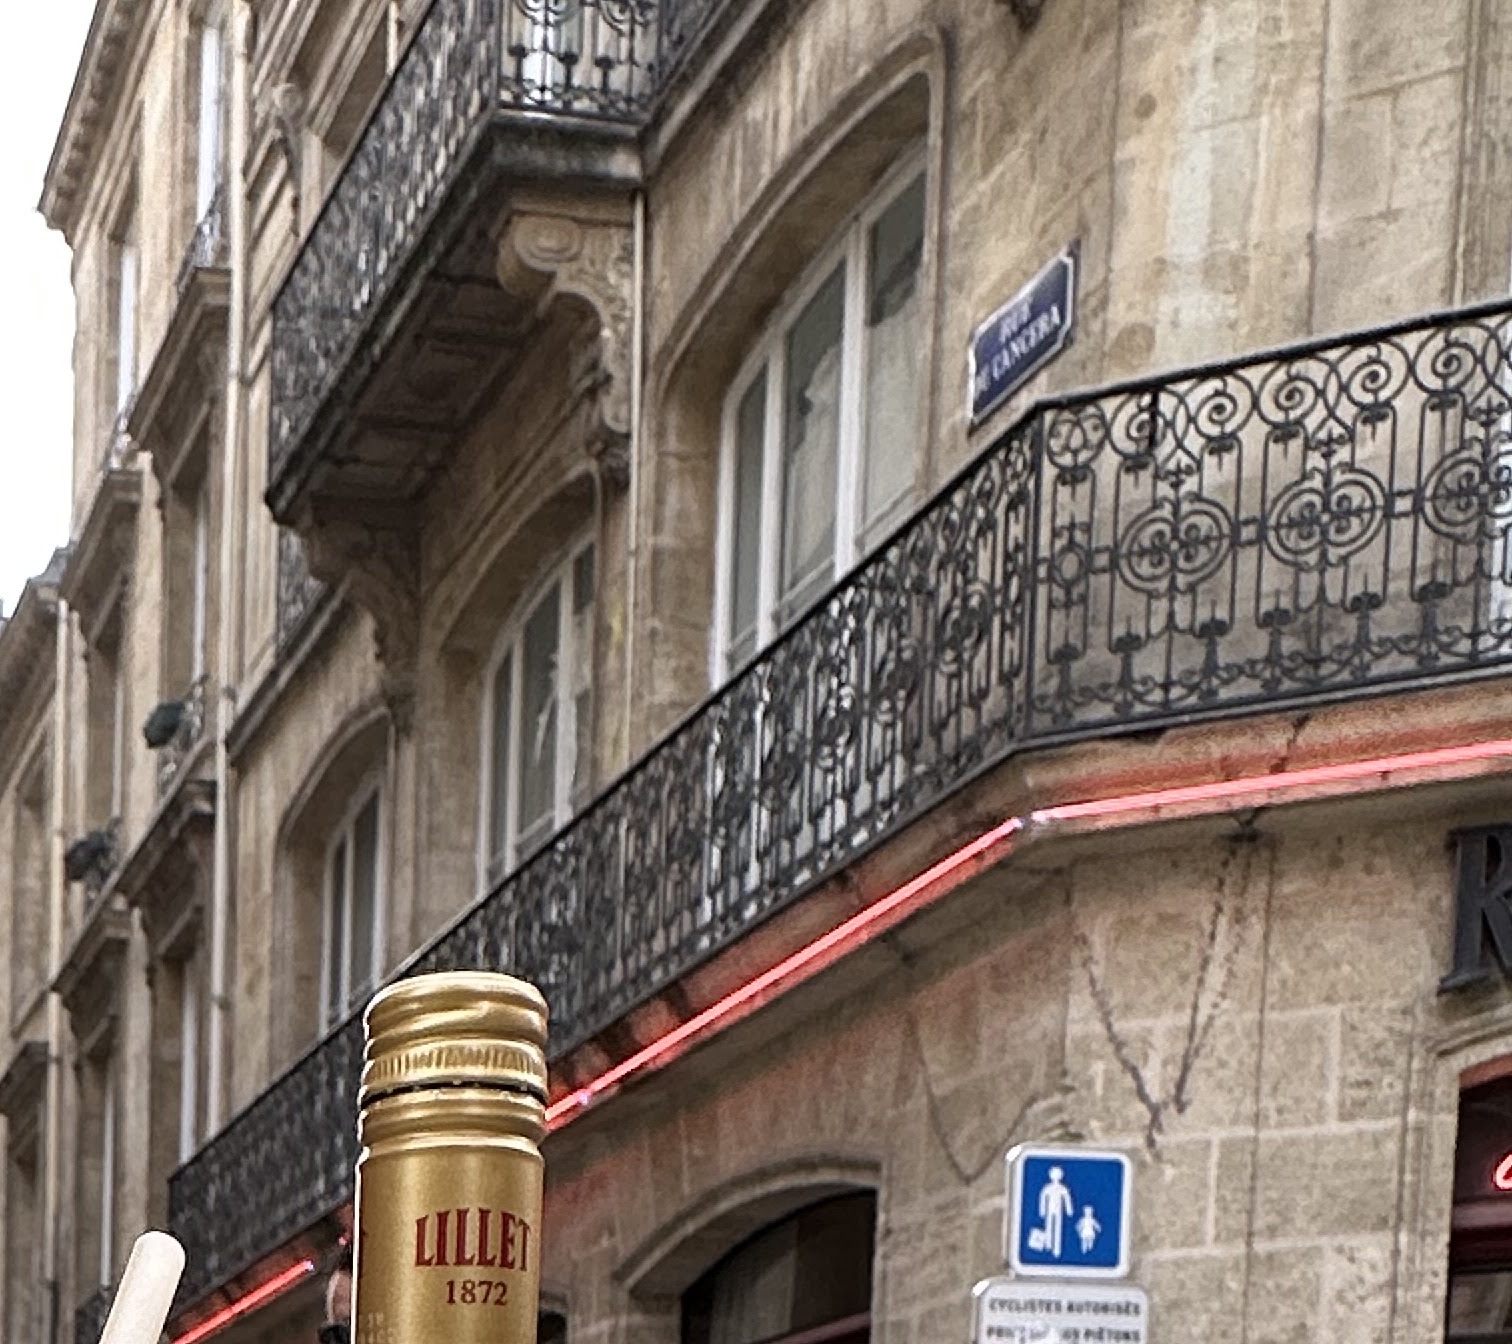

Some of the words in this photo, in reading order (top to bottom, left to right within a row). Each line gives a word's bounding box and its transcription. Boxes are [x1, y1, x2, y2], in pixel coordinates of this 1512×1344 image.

[414, 1207, 531, 1272] LILLET
[446, 1279, 508, 1306] 1872
[988, 1298, 1062, 1314] CYCLISTES
